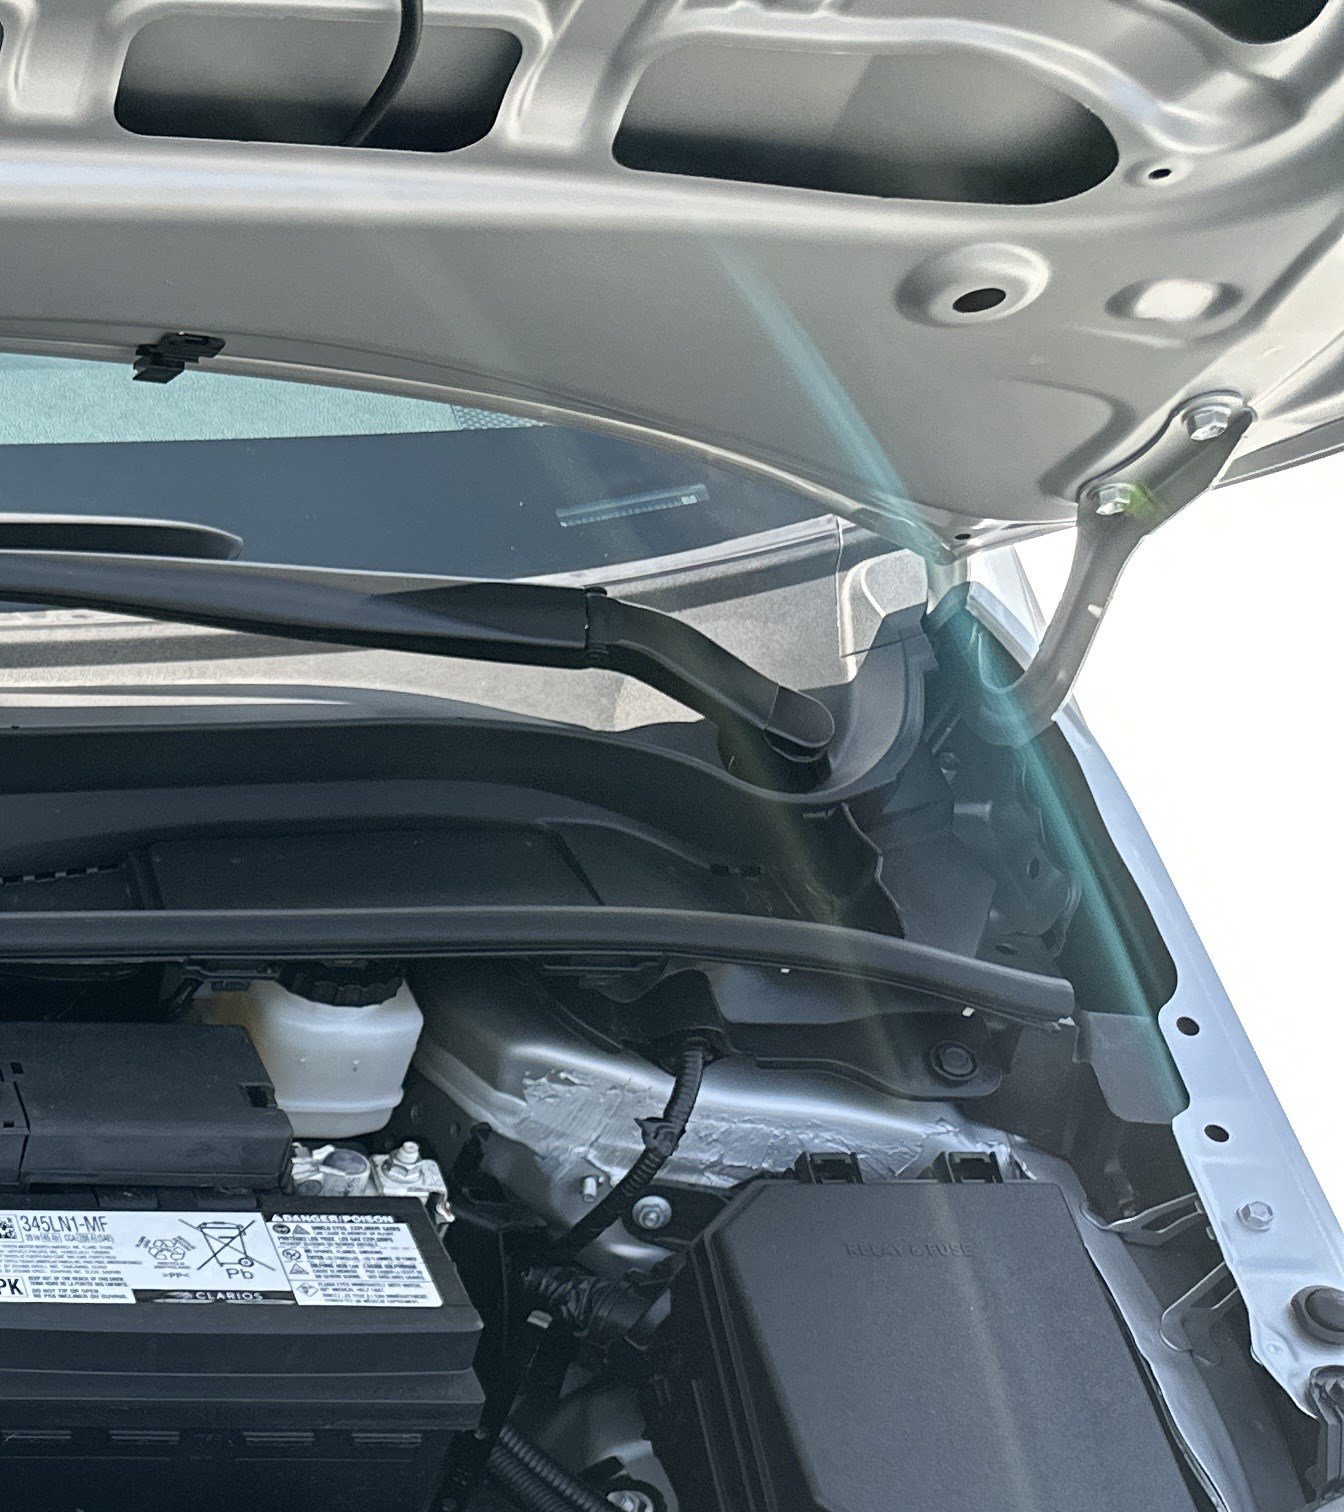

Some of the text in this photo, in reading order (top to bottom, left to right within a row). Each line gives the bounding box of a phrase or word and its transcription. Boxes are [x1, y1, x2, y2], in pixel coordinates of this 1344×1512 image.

[20, 1215, 109, 1233] 345LN1-MF
[225, 1267, 255, 1280] Pb
[195, 1291, 263, 1301] CLARIOS
